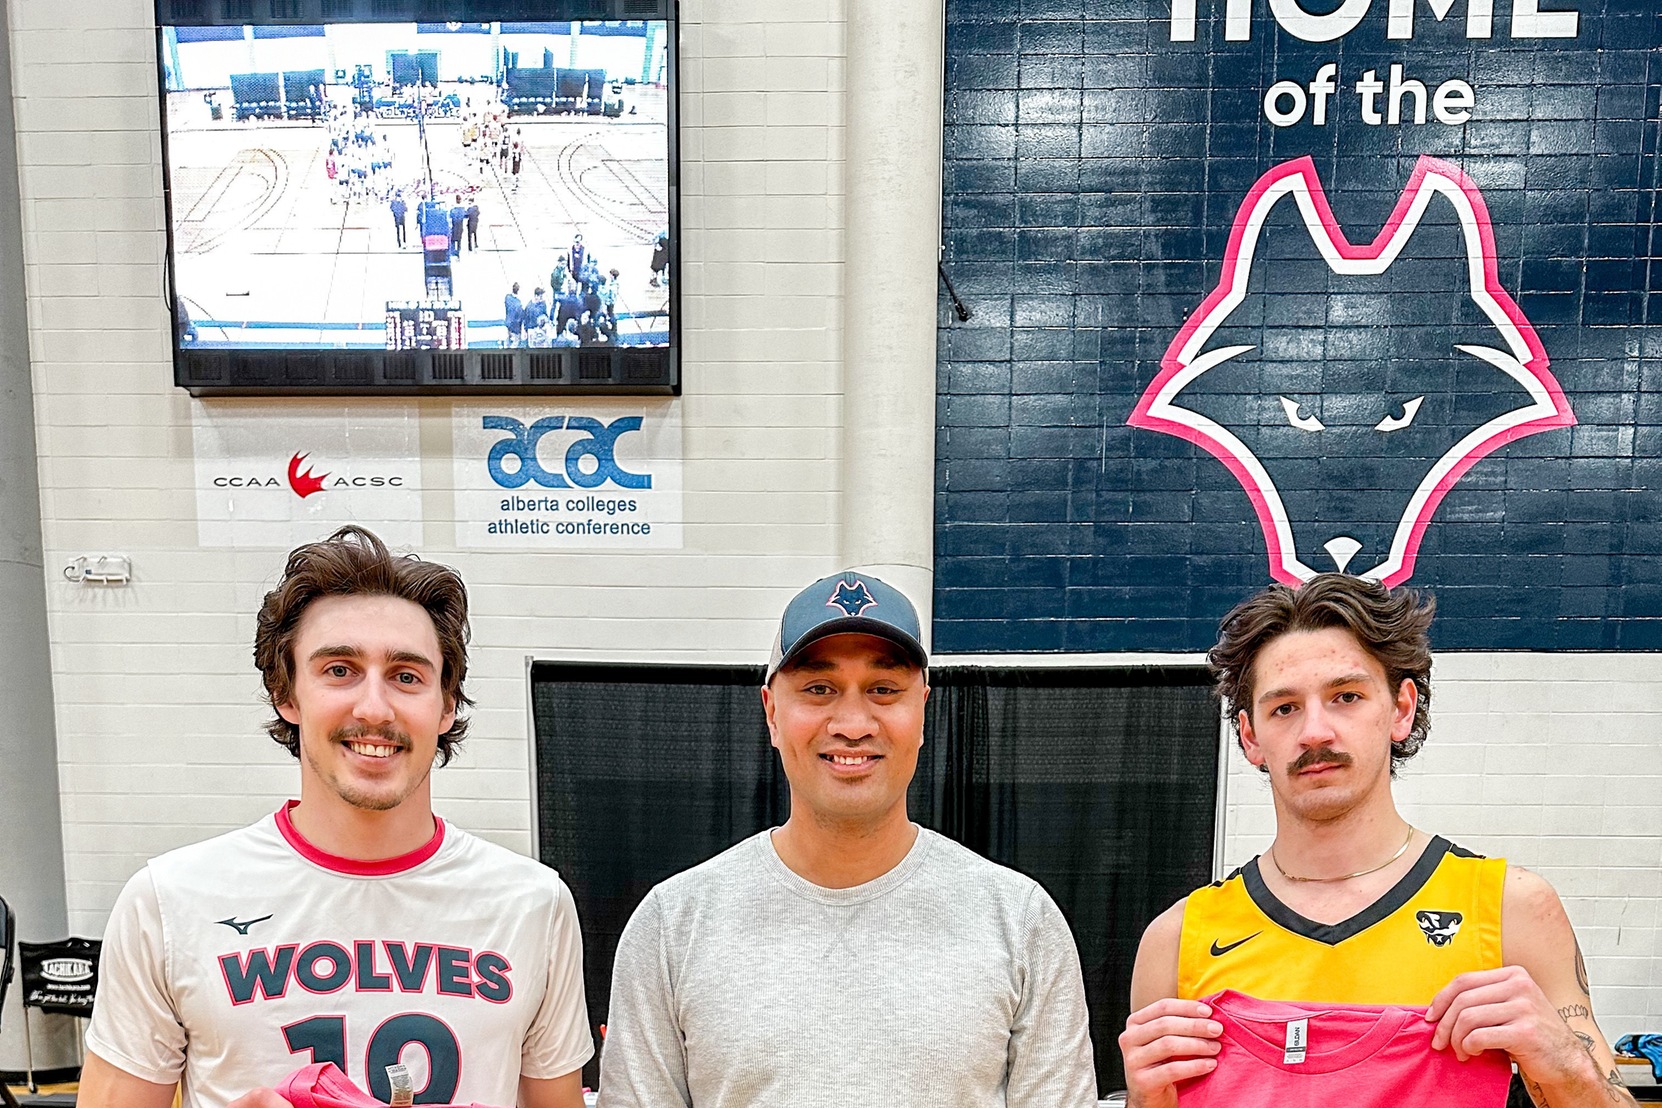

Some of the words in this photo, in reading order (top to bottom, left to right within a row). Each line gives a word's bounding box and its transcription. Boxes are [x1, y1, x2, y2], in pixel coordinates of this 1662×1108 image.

[1264, 63, 1337, 127] of
[1355, 63, 1475, 126] the
[482, 415, 652, 490] acac
[213, 476, 281, 487] CCAA
[334, 476, 403, 487] ACSC
[488, 519, 550, 535] athletic
[555, 519, 651, 535] conference
[500, 496, 559, 512] alberta
[565, 496, 637, 516] colleges
[217, 939, 513, 1006] WOLVES
